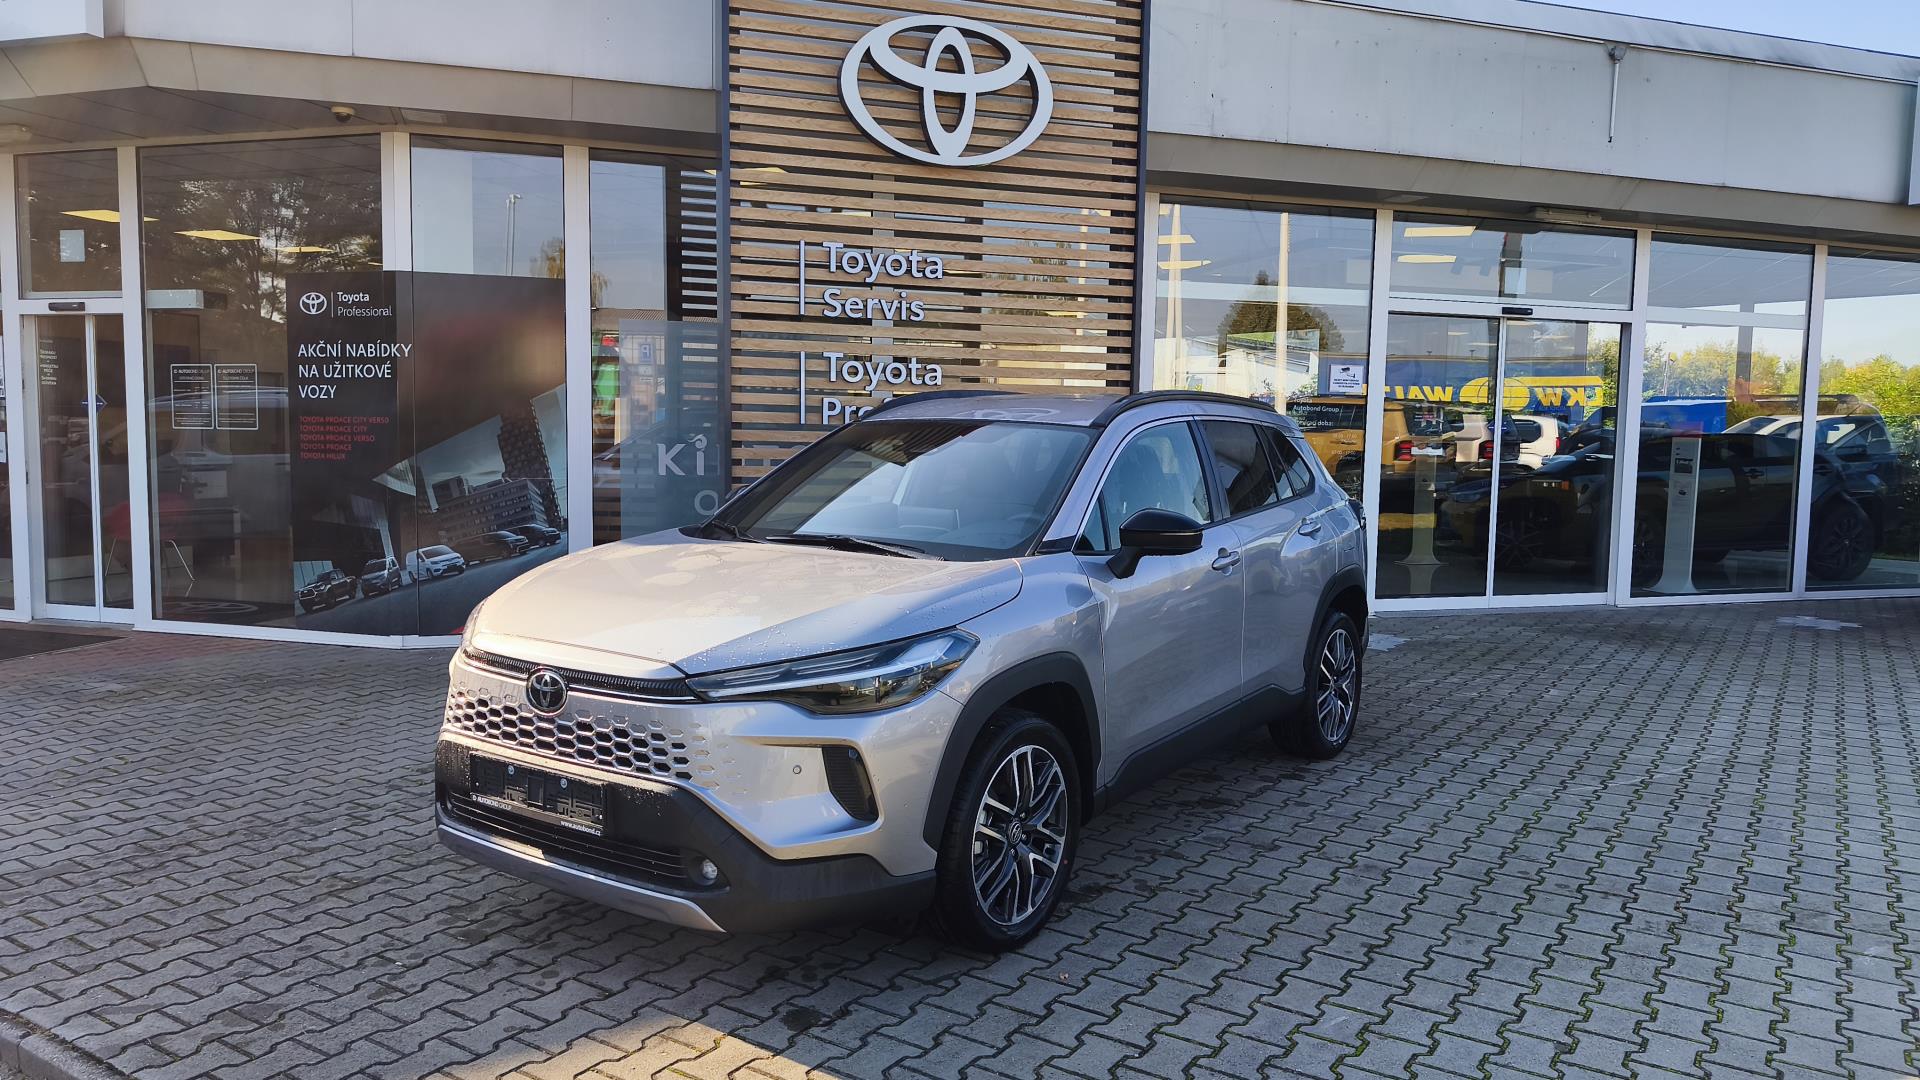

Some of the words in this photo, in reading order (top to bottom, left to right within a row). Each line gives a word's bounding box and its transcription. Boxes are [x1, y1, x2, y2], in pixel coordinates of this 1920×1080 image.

[822, 241, 944, 283] Toyota
[336, 291, 370, 304] Toyota
[823, 288, 926, 322] Servis
[337, 305, 393, 317] Professional
[298, 340, 342, 358] AKČNÍ
[346, 340, 412, 358] NABÍDKY
[298, 364, 320, 378] NA
[323, 361, 392, 378] UŽITKOVÉ
[822, 351, 943, 392] Toyota
[298, 384, 337, 399] VOZY
[1292, 404, 1321, 412] Autobond
[1321, 405, 1340, 413] Group
